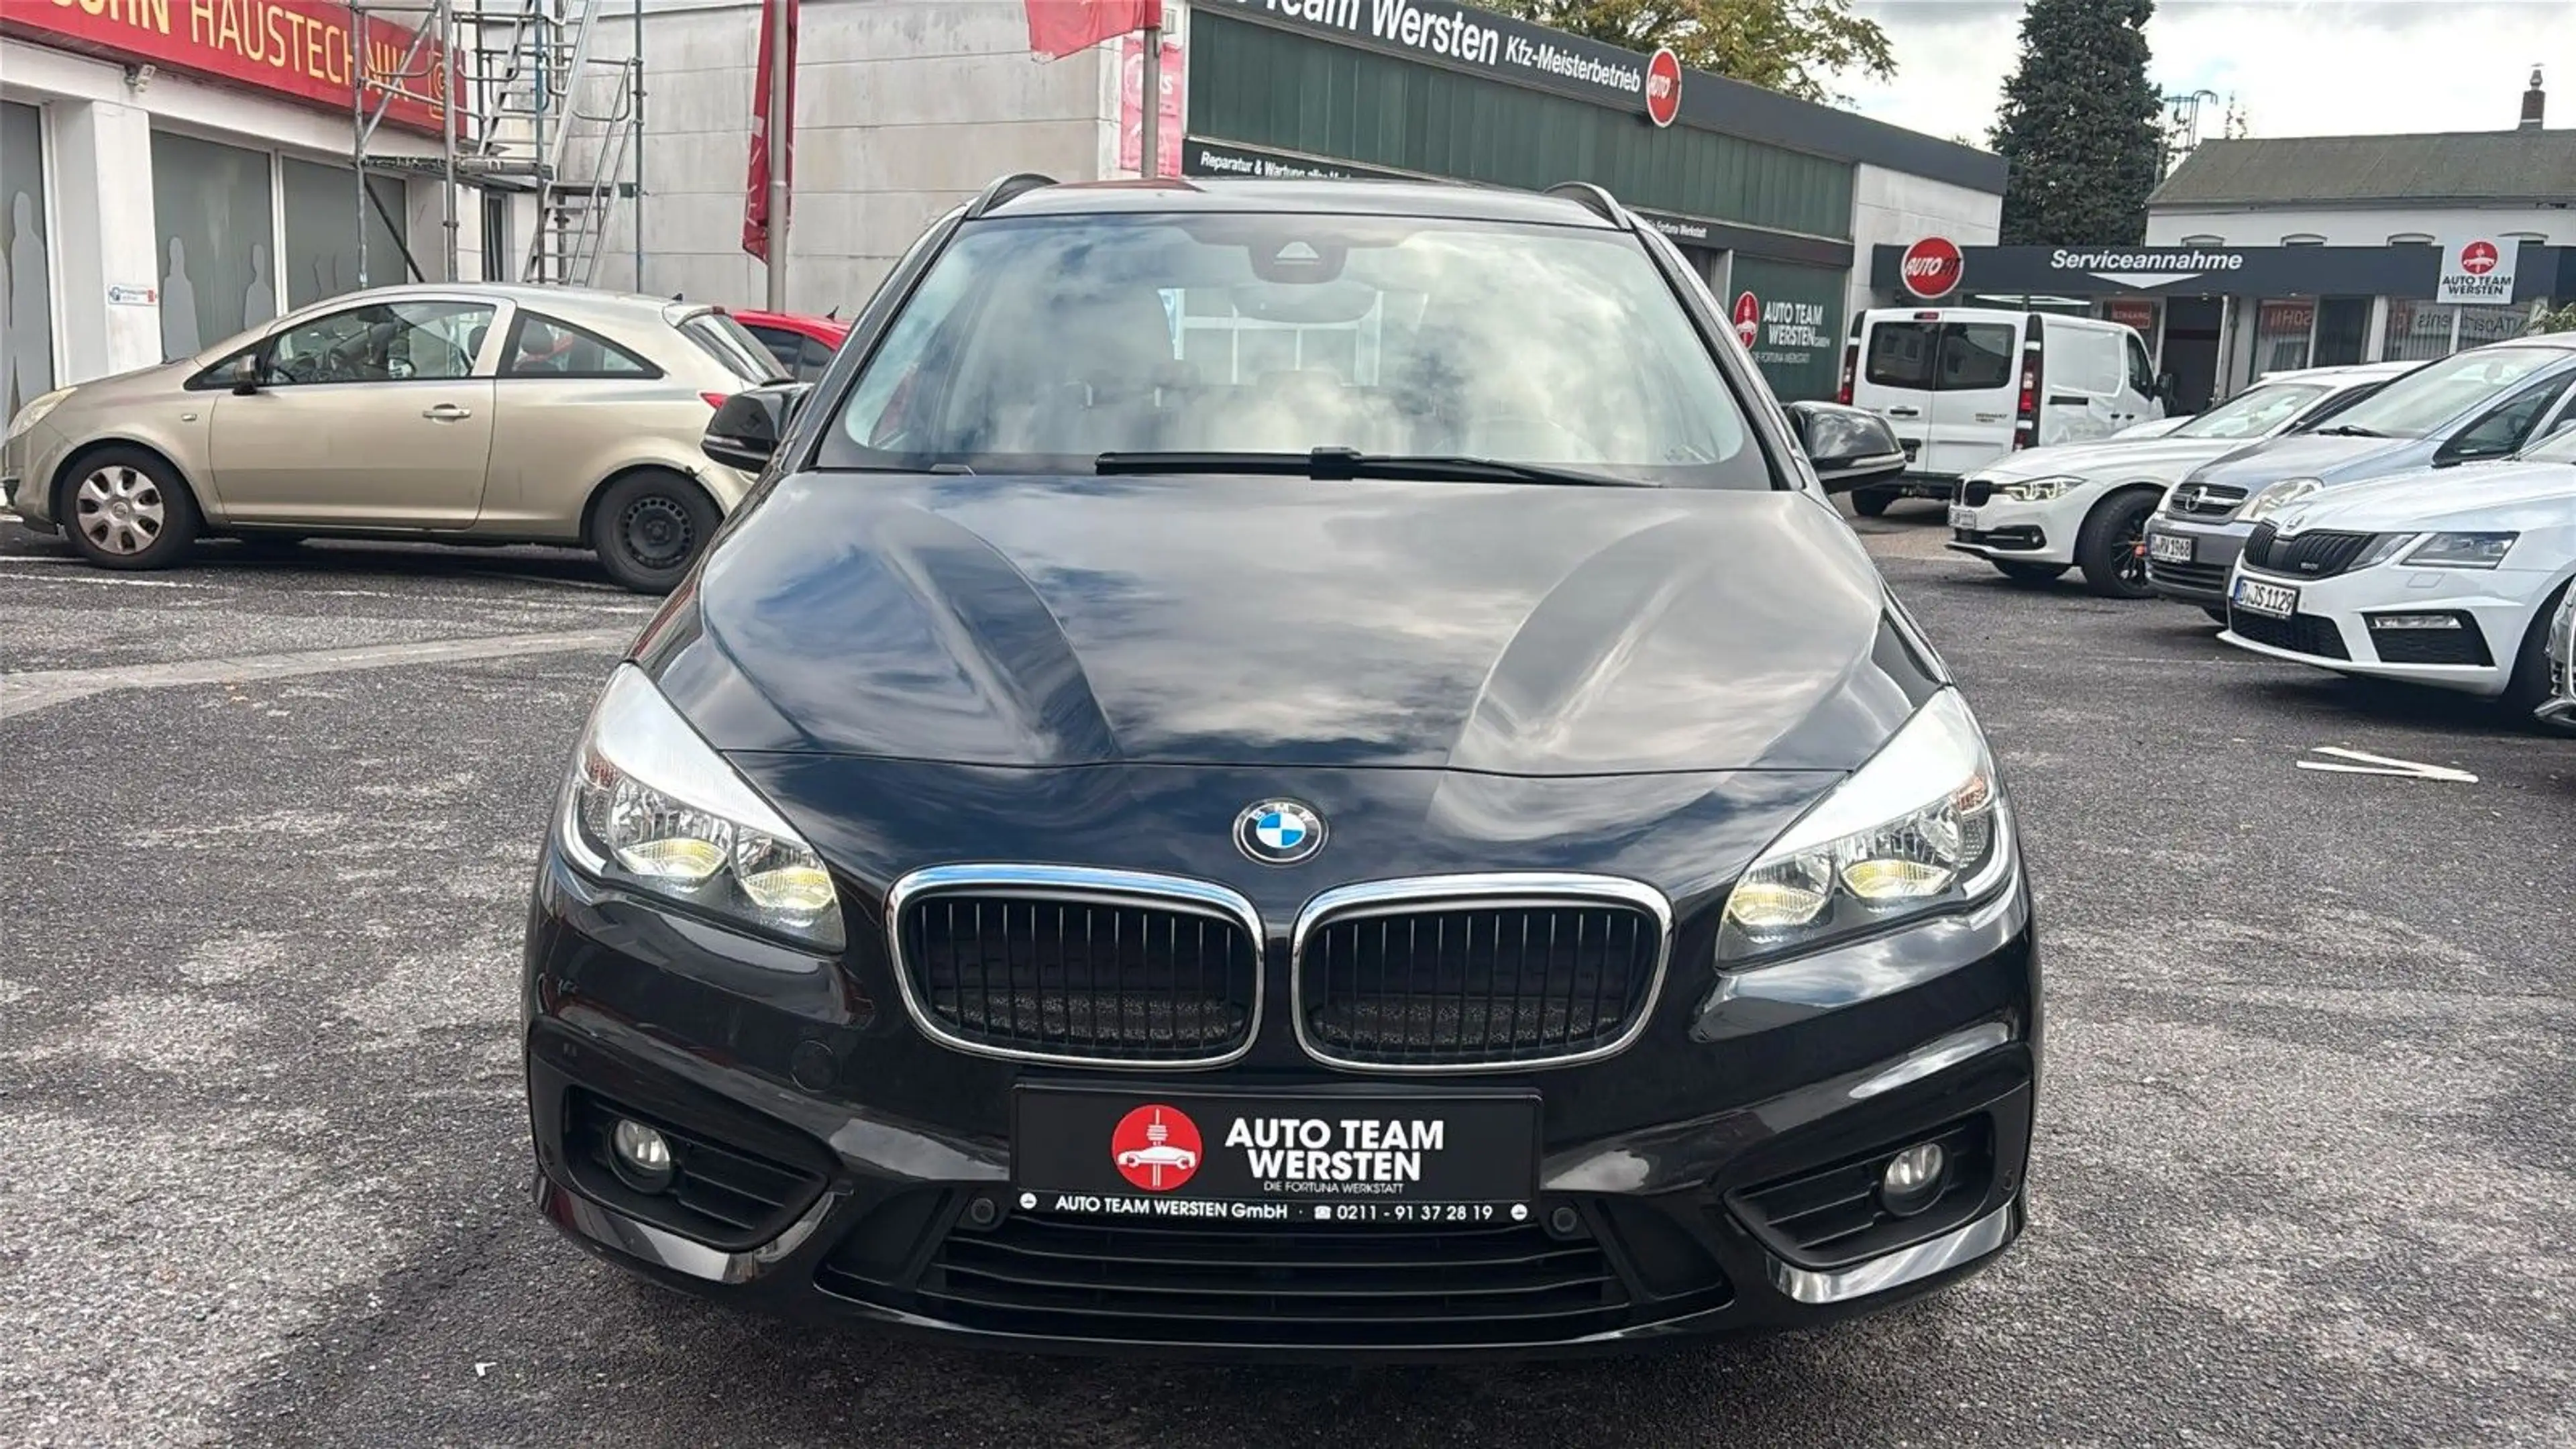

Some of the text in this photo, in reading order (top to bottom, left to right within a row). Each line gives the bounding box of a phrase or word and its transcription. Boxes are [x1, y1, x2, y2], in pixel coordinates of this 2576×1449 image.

[1266, 0, 1641, 93] am Wersten Kfz-Meisterbetrieb
[1200, 150, 1253, 173] Reparatur
[1904, 257, 1943, 276] AUTO
[2051, 249, 2243, 269] Serviceannahme
[2442, 276, 2512, 286] AUTO TEAM
[2449, 284, 2504, 295] WERSTEN
[1763, 301, 1823, 326] AUTO TEAM
[1768, 323, 1816, 347] WERSTEN
[2265, 588, 2294, 613] 1129
[1225, 1118, 1444, 1150] AUTO TEAM
[1247, 1149, 1421, 1181] WERSTEN
[1264, 1181, 1404, 1194] DIE FORTUNA WERKSTATT
[1055, 1195, 1100, 1212] AUTO
[1104, 1197, 1149, 1214] TEAM
[1153, 1199, 1227, 1217] WERSTEN
[1231, 1203, 1287, 1220] GmbH
[1336, 1205, 1376, 1220] 0211
[1394, 1205, 1413, 1220] 91
[1420, 1205, 1441, 1220] 37
[1446, 1205, 1467, 1220] 28
[1472, 1205, 1493, 1220] 19
